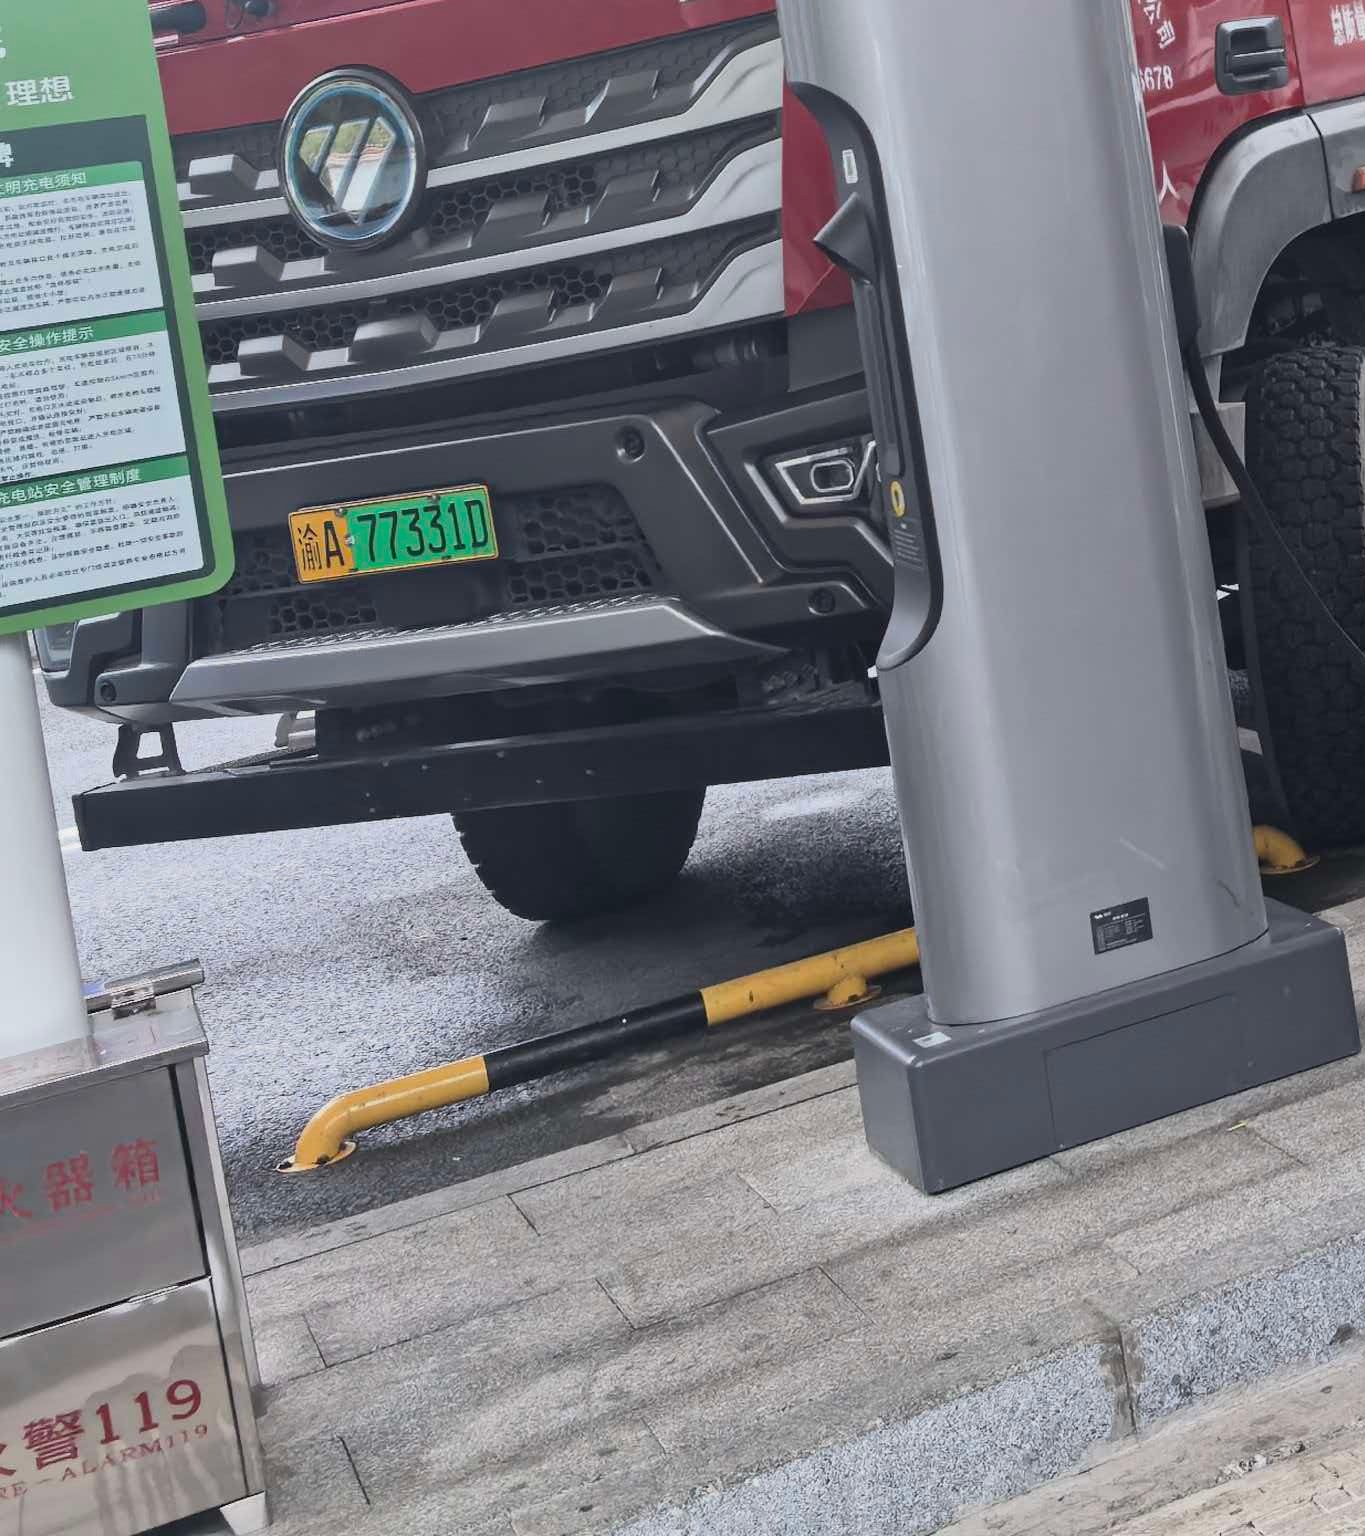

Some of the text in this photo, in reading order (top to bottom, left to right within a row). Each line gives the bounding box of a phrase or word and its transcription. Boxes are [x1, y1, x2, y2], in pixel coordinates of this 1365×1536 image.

[5, 75, 75, 107] 理想
[0, 325, 94, 353] 安全操作提示
[297, 499, 489, 571] 渝A77331D
